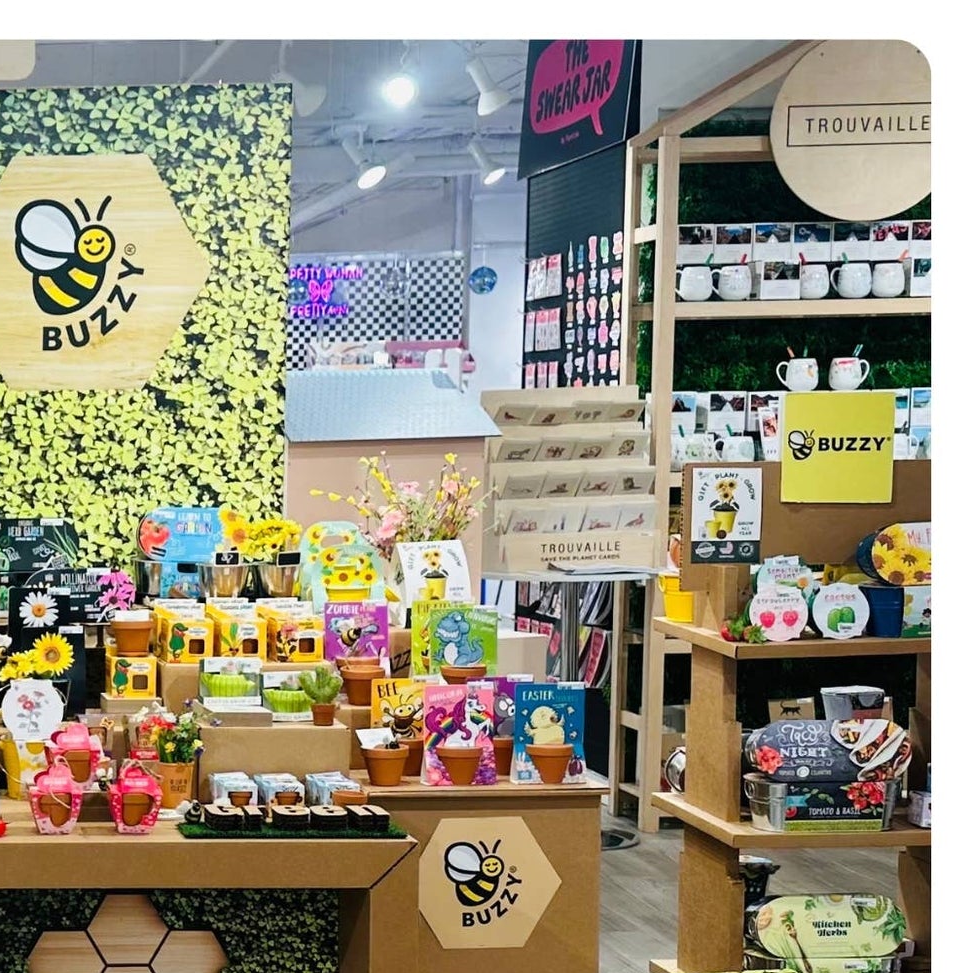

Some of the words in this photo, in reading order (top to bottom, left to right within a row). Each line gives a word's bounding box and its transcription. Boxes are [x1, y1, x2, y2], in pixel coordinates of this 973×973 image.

[565, 39, 589, 73] THE
[535, 73, 580, 124] SWEAR
[582, 59, 612, 104] JAR
[804, 114, 931, 134] TROUVAILLE
[42, 256, 145, 351] BUZZY
[817, 437, 887, 452] BUZZY
[714, 471, 740, 480] PLANT
[540, 541, 622, 554] TROUVAILLE
[326, 604, 360, 615] ZOMBIE
[376, 681, 400, 699] BEE
[521, 690, 556, 702] EASTER
[779, 746, 829, 758] NIGHT
[808, 807, 834, 816] TOMATO
[842, 806, 862, 815] BASIL
[461, 872, 523, 928] BUZZY
[812, 920, 852, 929] Kitchen
[816, 929, 848, 937] Herbs
